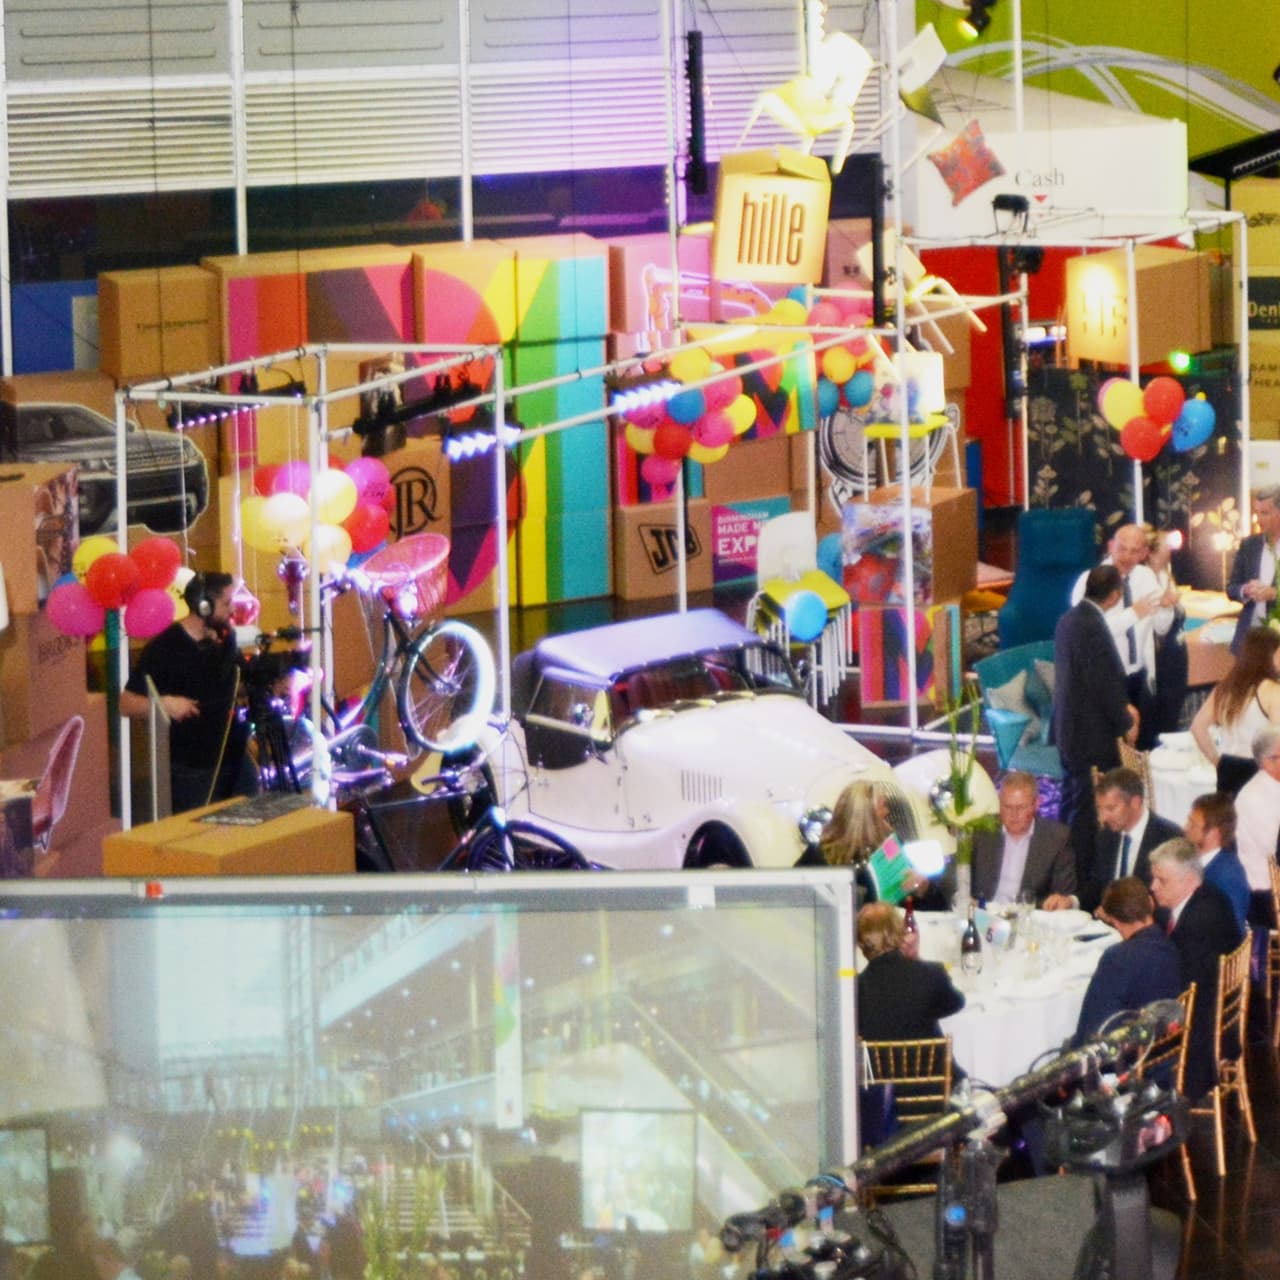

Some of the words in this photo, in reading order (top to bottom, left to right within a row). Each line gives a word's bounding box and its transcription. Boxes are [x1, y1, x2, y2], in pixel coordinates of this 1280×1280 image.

[1014, 168, 1065, 187] Cash
[737, 191, 806, 266] hille
[717, 522, 748, 535] MADE
[717, 535, 759, 556] EXP
